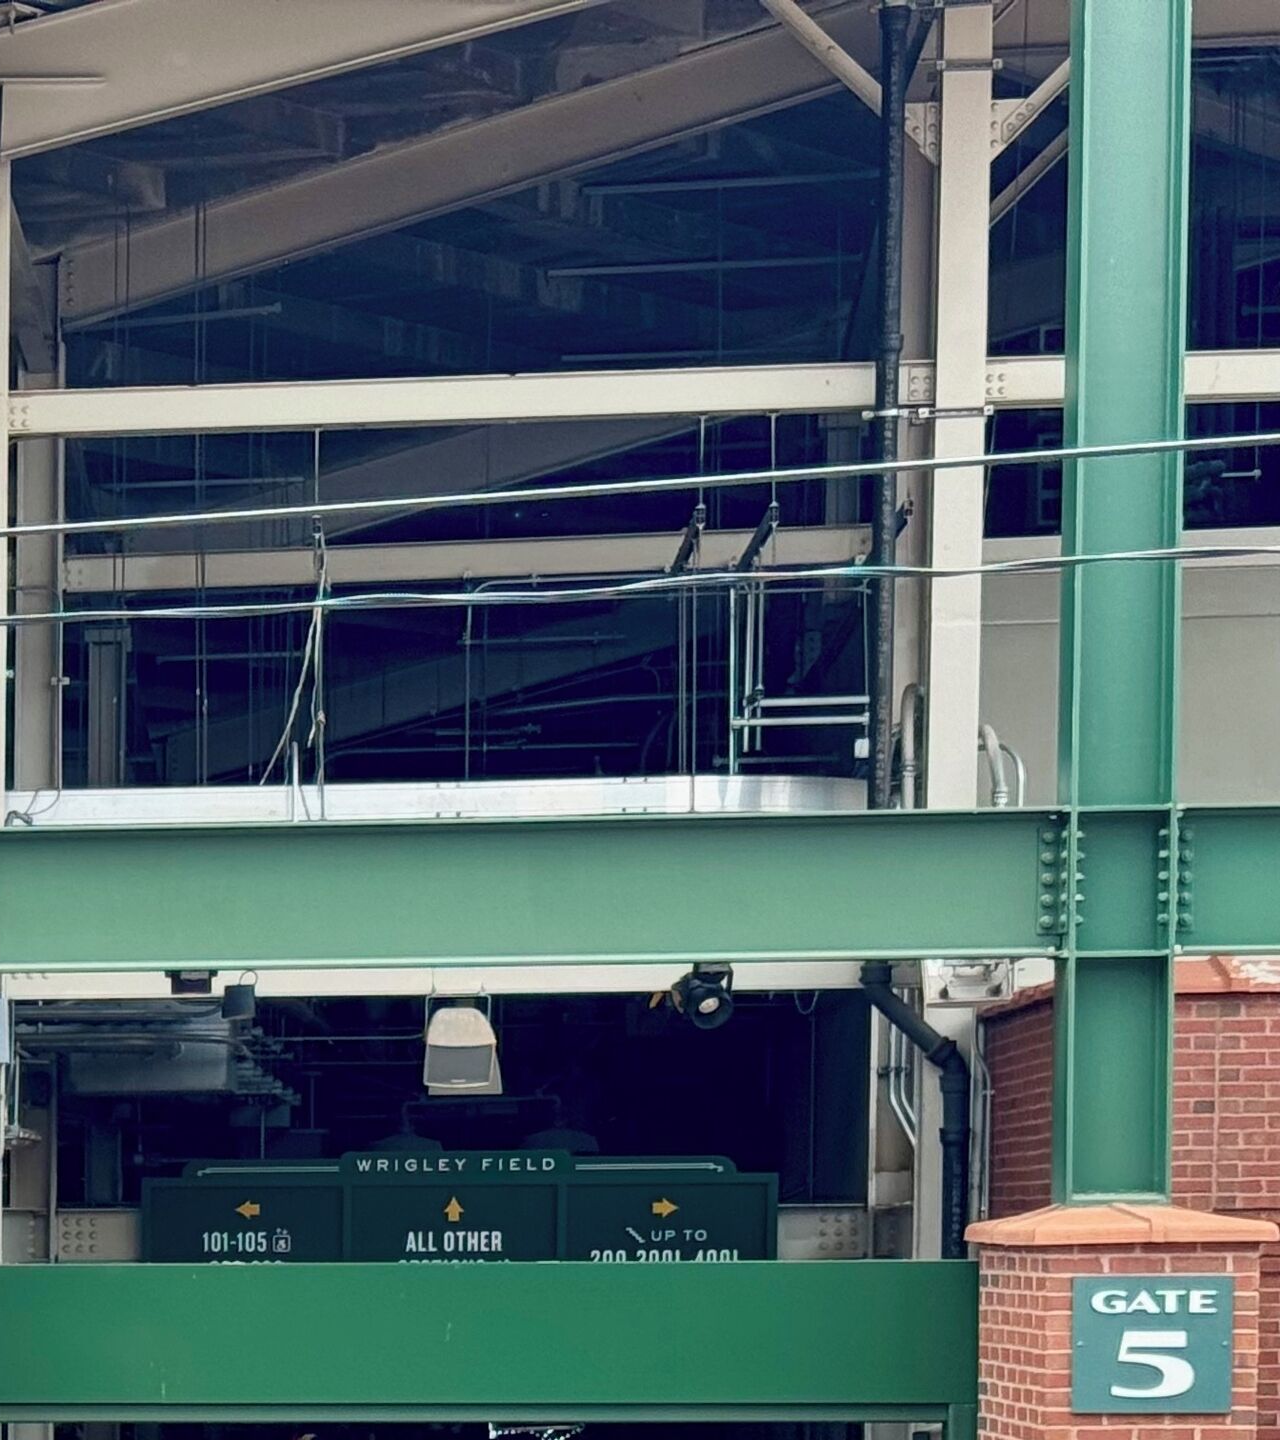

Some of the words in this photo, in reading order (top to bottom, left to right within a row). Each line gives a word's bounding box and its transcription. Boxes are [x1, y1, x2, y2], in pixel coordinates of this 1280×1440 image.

[356, 1159, 467, 1172] WRIGLEY
[481, 1158, 556, 1171] FIELD
[202, 1231, 268, 1252] 101-105
[405, 1231, 438, 1252] ALL
[443, 1231, 503, 1252] OTHER
[650, 1229, 676, 1241] UP
[683, 1229, 708, 1242] TO
[1090, 1289, 1218, 1314] GATE
[1110, 1330, 1195, 1398] 5
